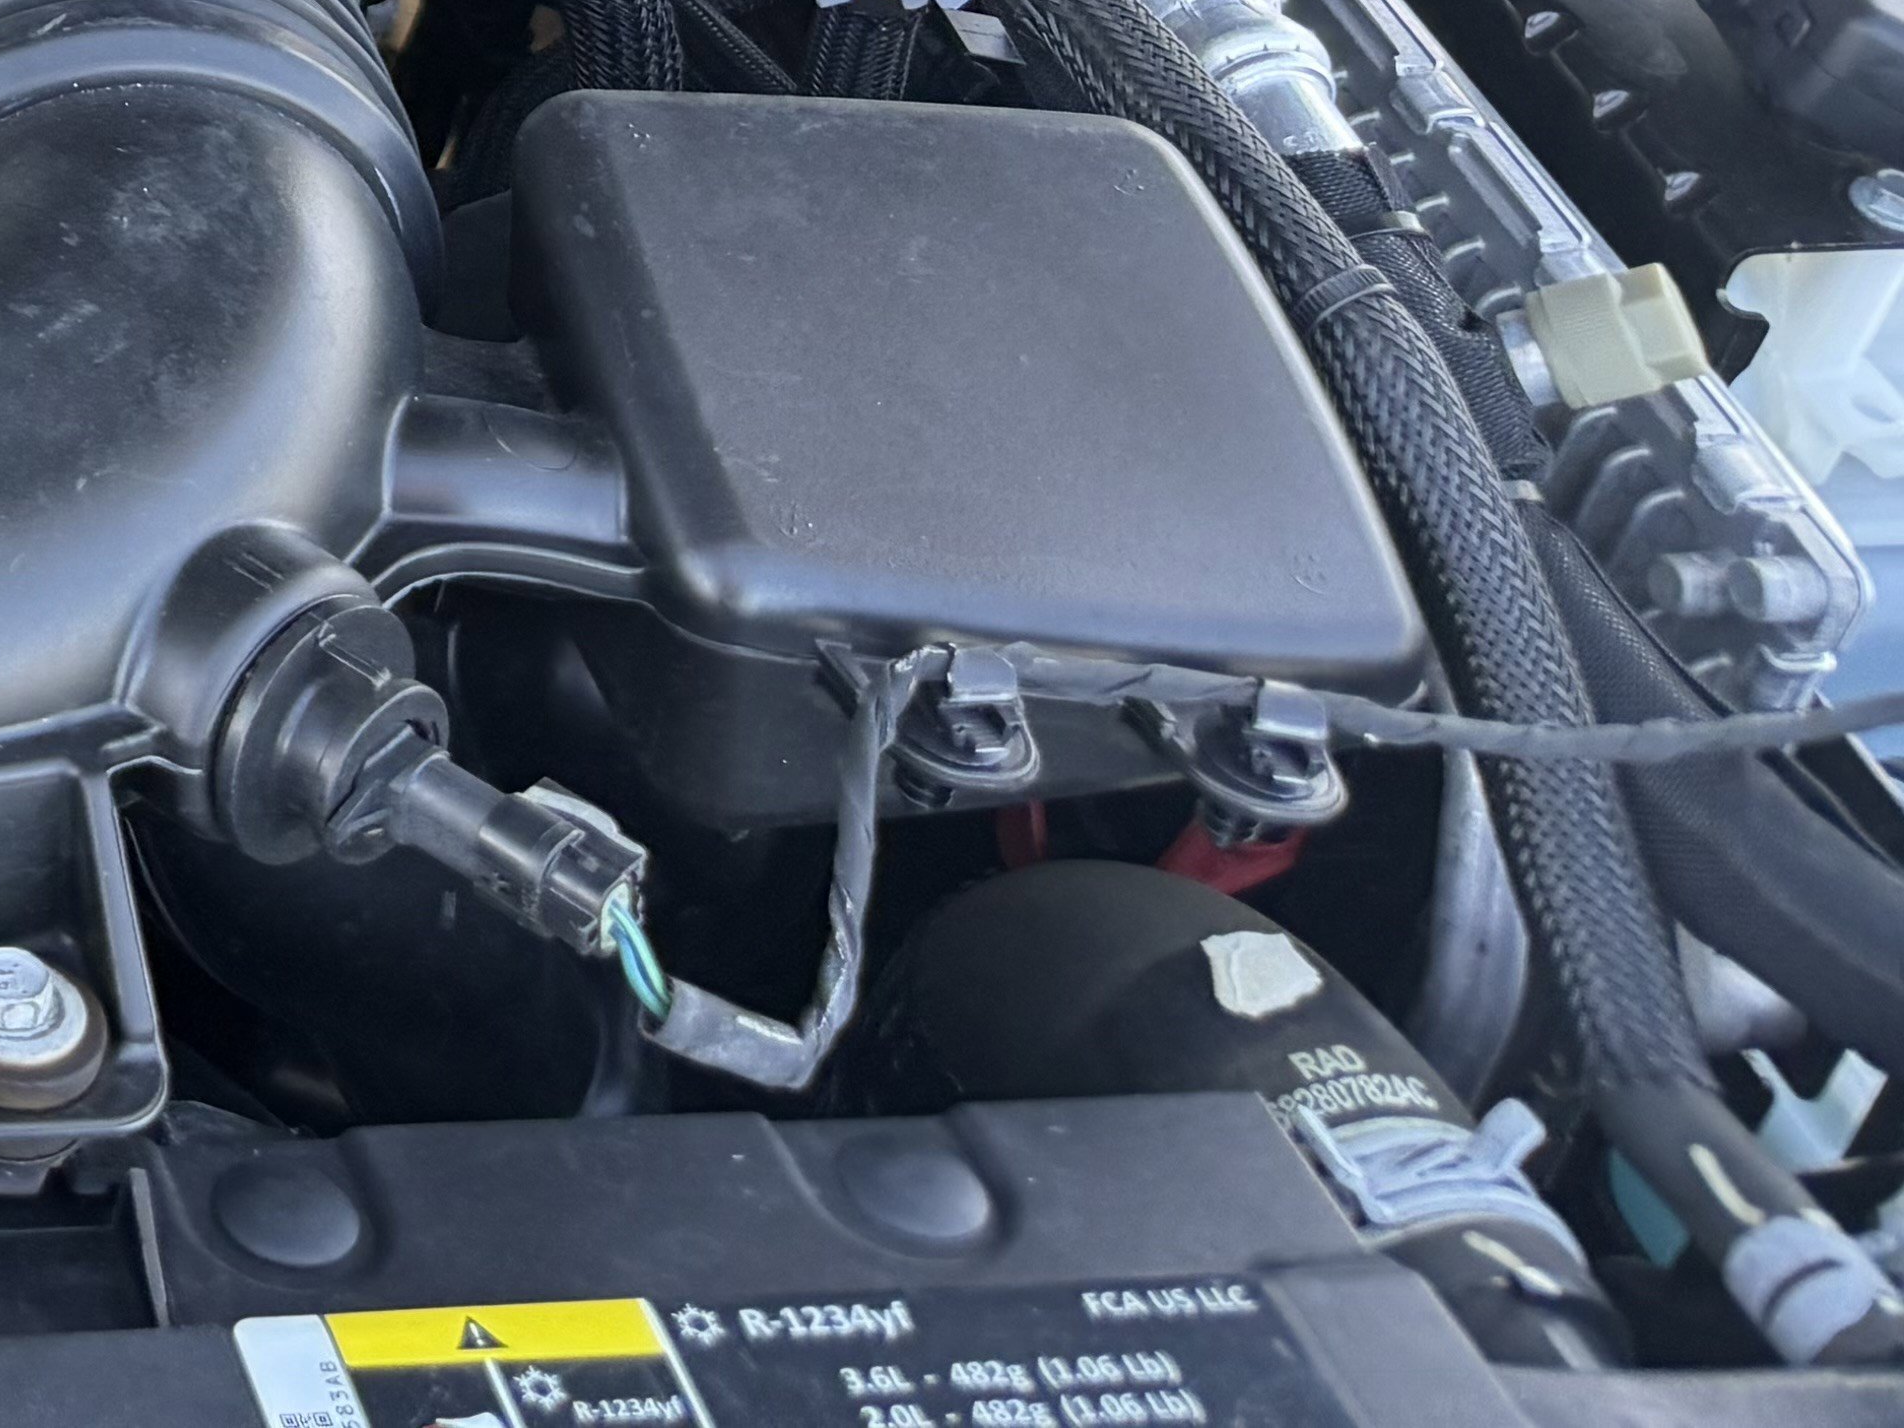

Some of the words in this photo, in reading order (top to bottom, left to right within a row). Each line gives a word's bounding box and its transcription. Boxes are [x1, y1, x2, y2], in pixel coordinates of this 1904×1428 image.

[1287, 1044, 1367, 1080] RAD
[1081, 1289, 1145, 1319] FCA
[1146, 1287, 1198, 1315] US
[1199, 1283, 1259, 1314] LLC
[737, 1300, 916, 1344] R-1234yf
[839, 1365, 916, 1397] 3.6L
[949, 1359, 1037, 1396] 482g
[1038, 1353, 1124, 1388] (1.06
[1127, 1349, 1182, 1386] Lb)
[571, 1394, 689, 1425] R-1234yf
